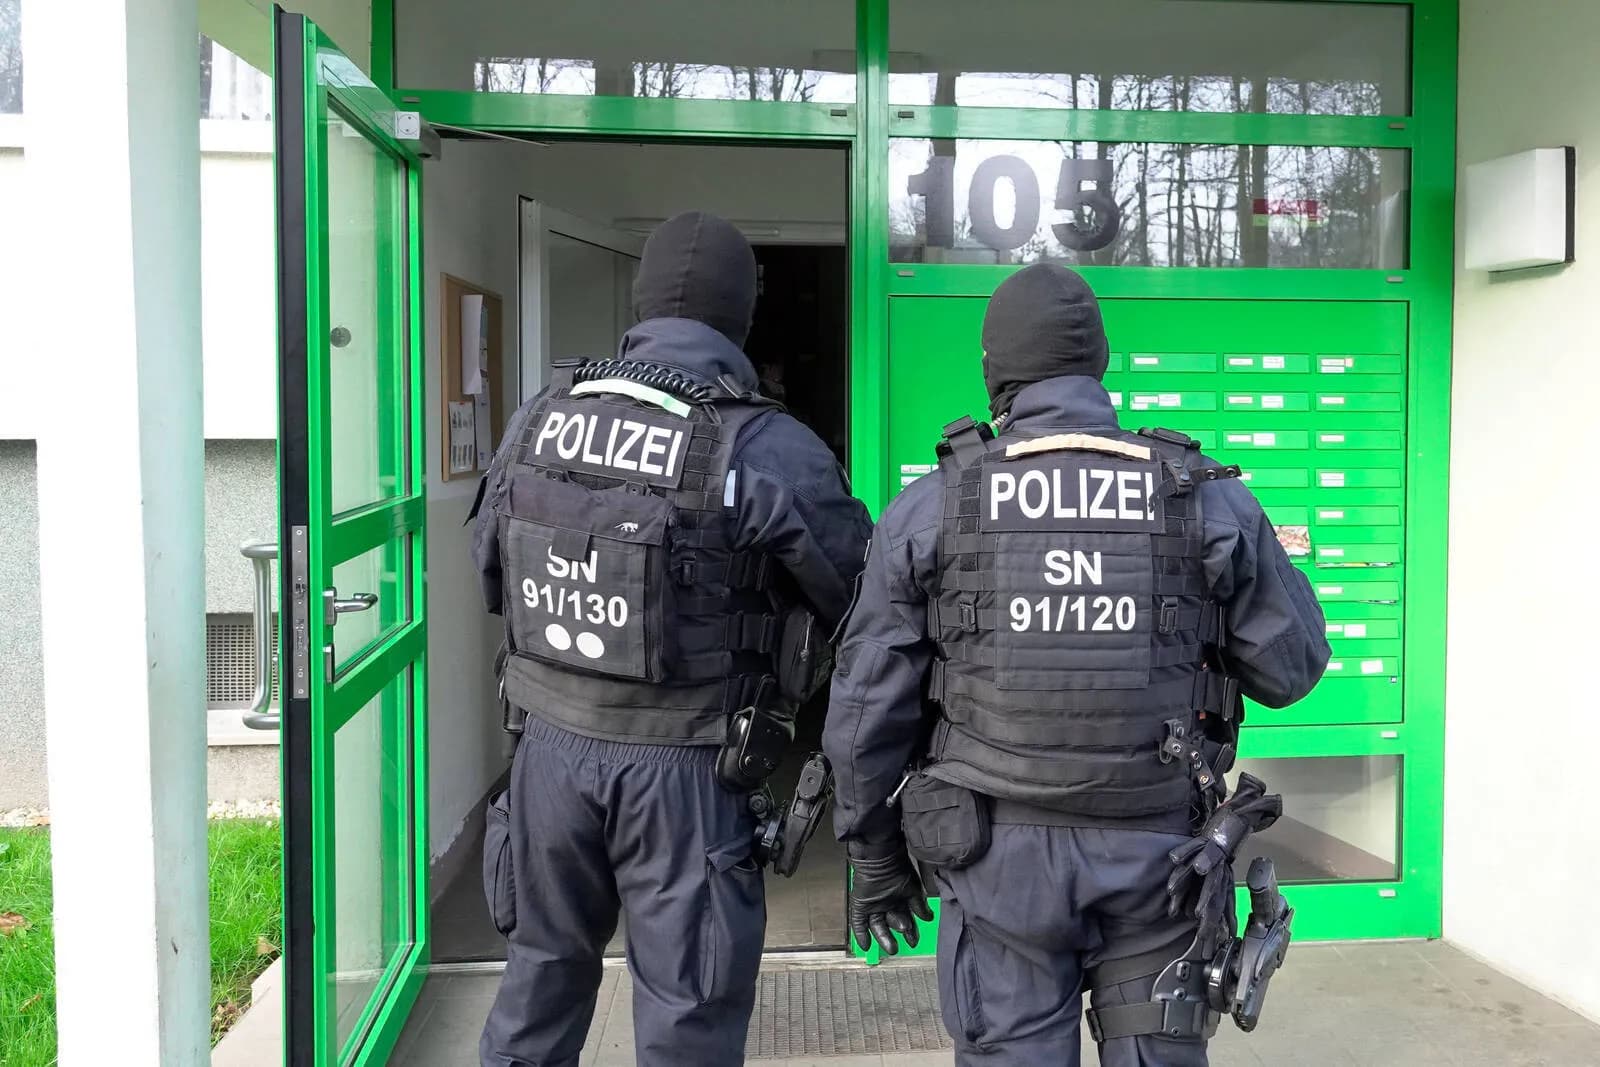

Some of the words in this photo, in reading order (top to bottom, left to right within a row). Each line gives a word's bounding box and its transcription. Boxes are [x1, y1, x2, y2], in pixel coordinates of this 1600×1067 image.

[908, 154, 1121, 252] 105
[534, 411, 684, 478] POLIZEI
[990, 468, 1155, 521] POLIZEI
[1043, 549, 1103, 586] SN
[521, 577, 628, 628] 91/130
[1009, 595, 1136, 632] 91/120
